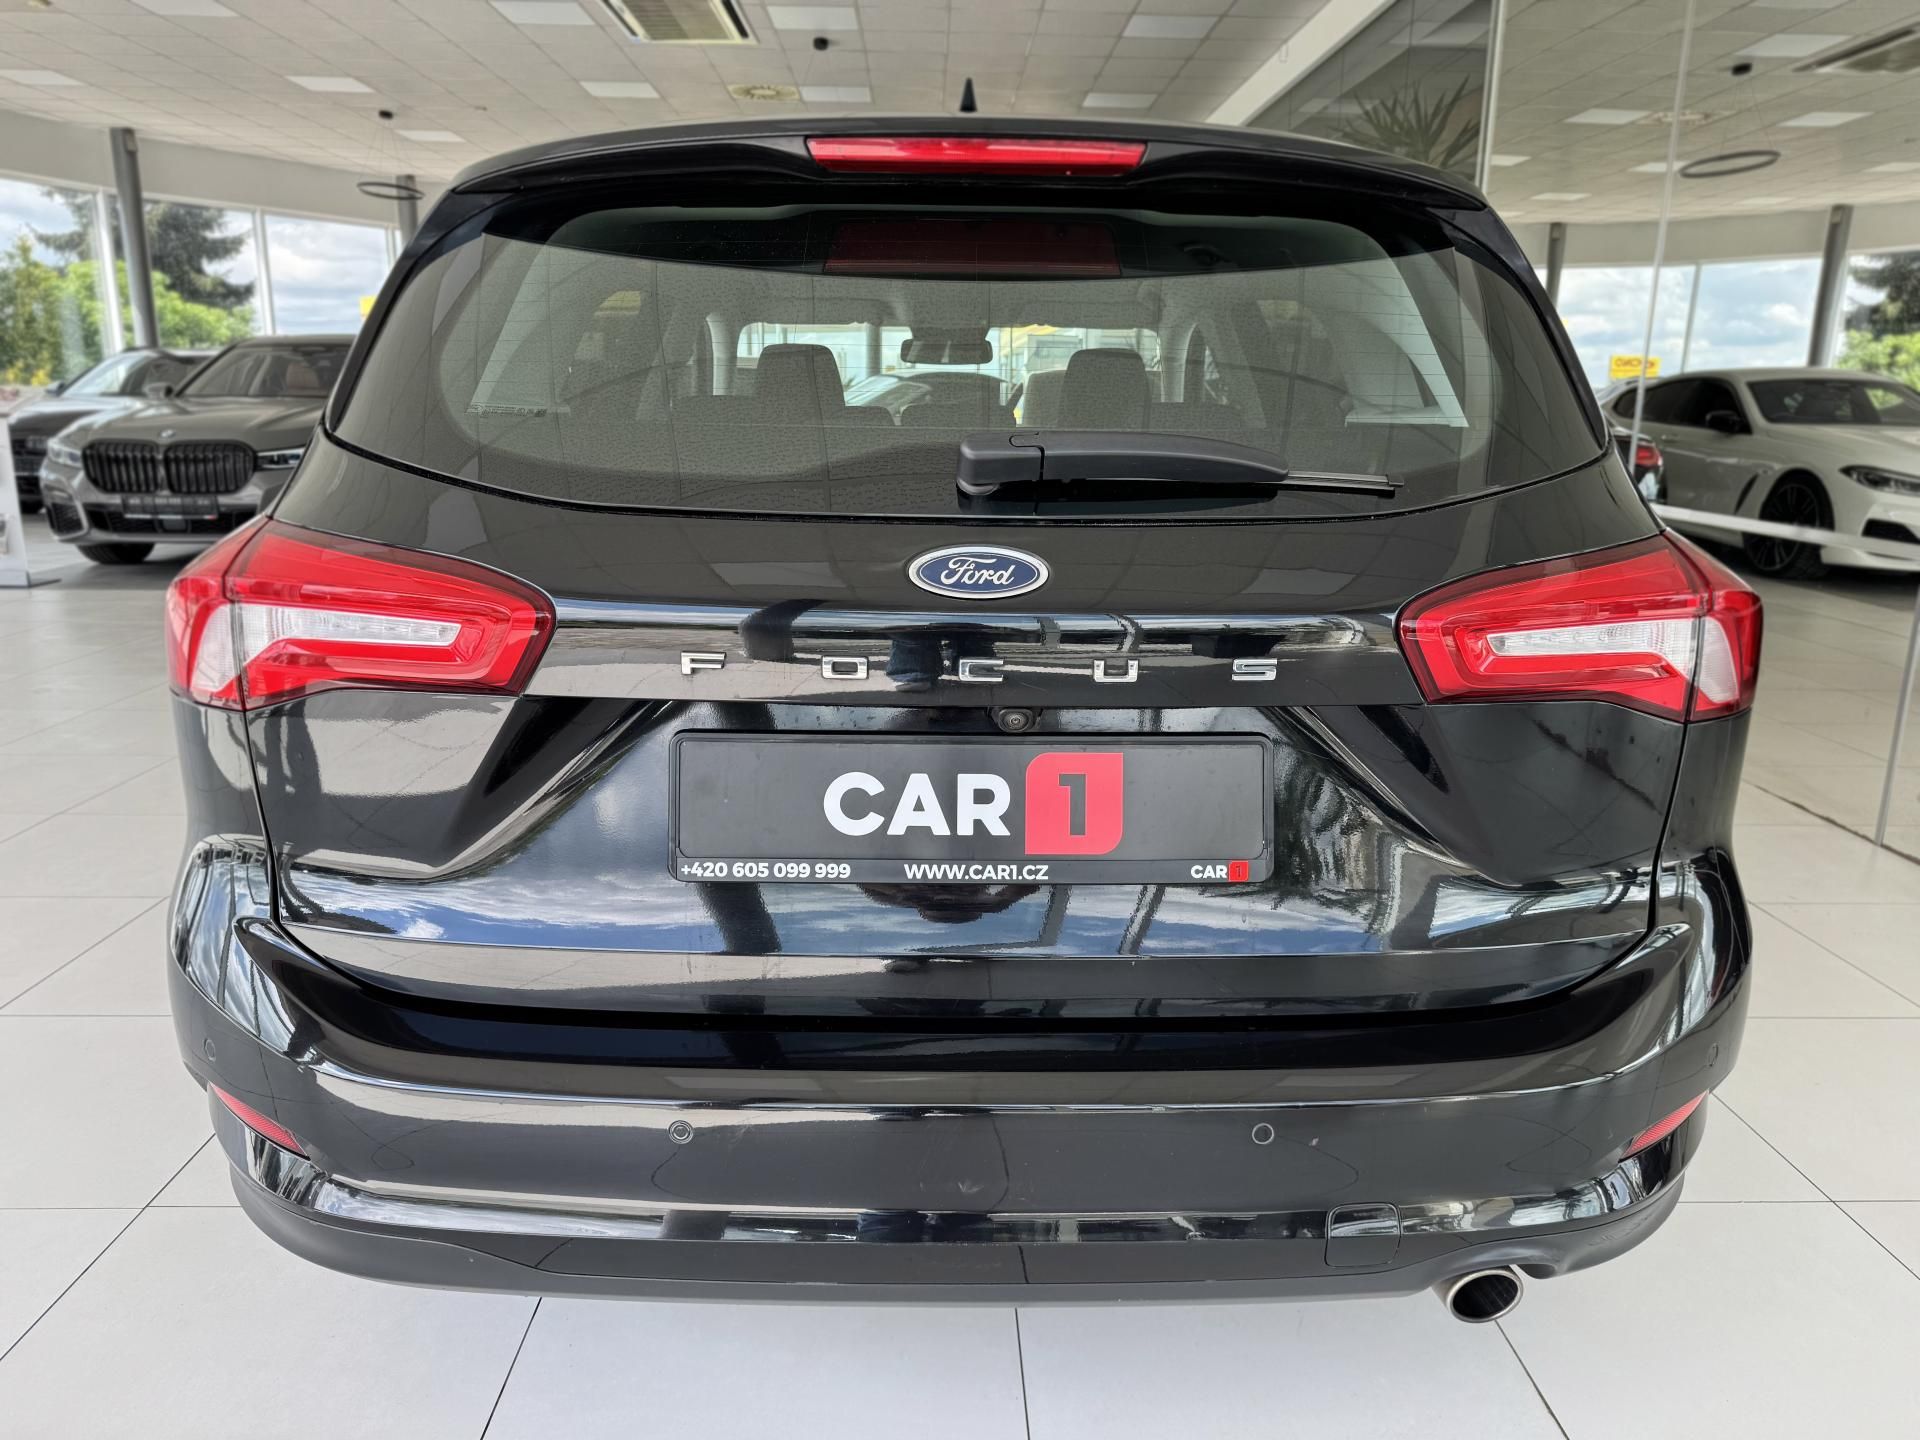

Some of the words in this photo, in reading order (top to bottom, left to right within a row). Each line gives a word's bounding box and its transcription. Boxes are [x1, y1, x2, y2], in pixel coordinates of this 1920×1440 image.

[940, 557, 1015, 586] Ford
[681, 651, 1278, 682] FOCUS
[681, 862, 728, 878] +420
[732, 862, 769, 878] 605
[773, 862, 811, 878] 099
[814, 863, 851, 878] 999
[904, 864, 1049, 880] WWW.CAR1.CZ
